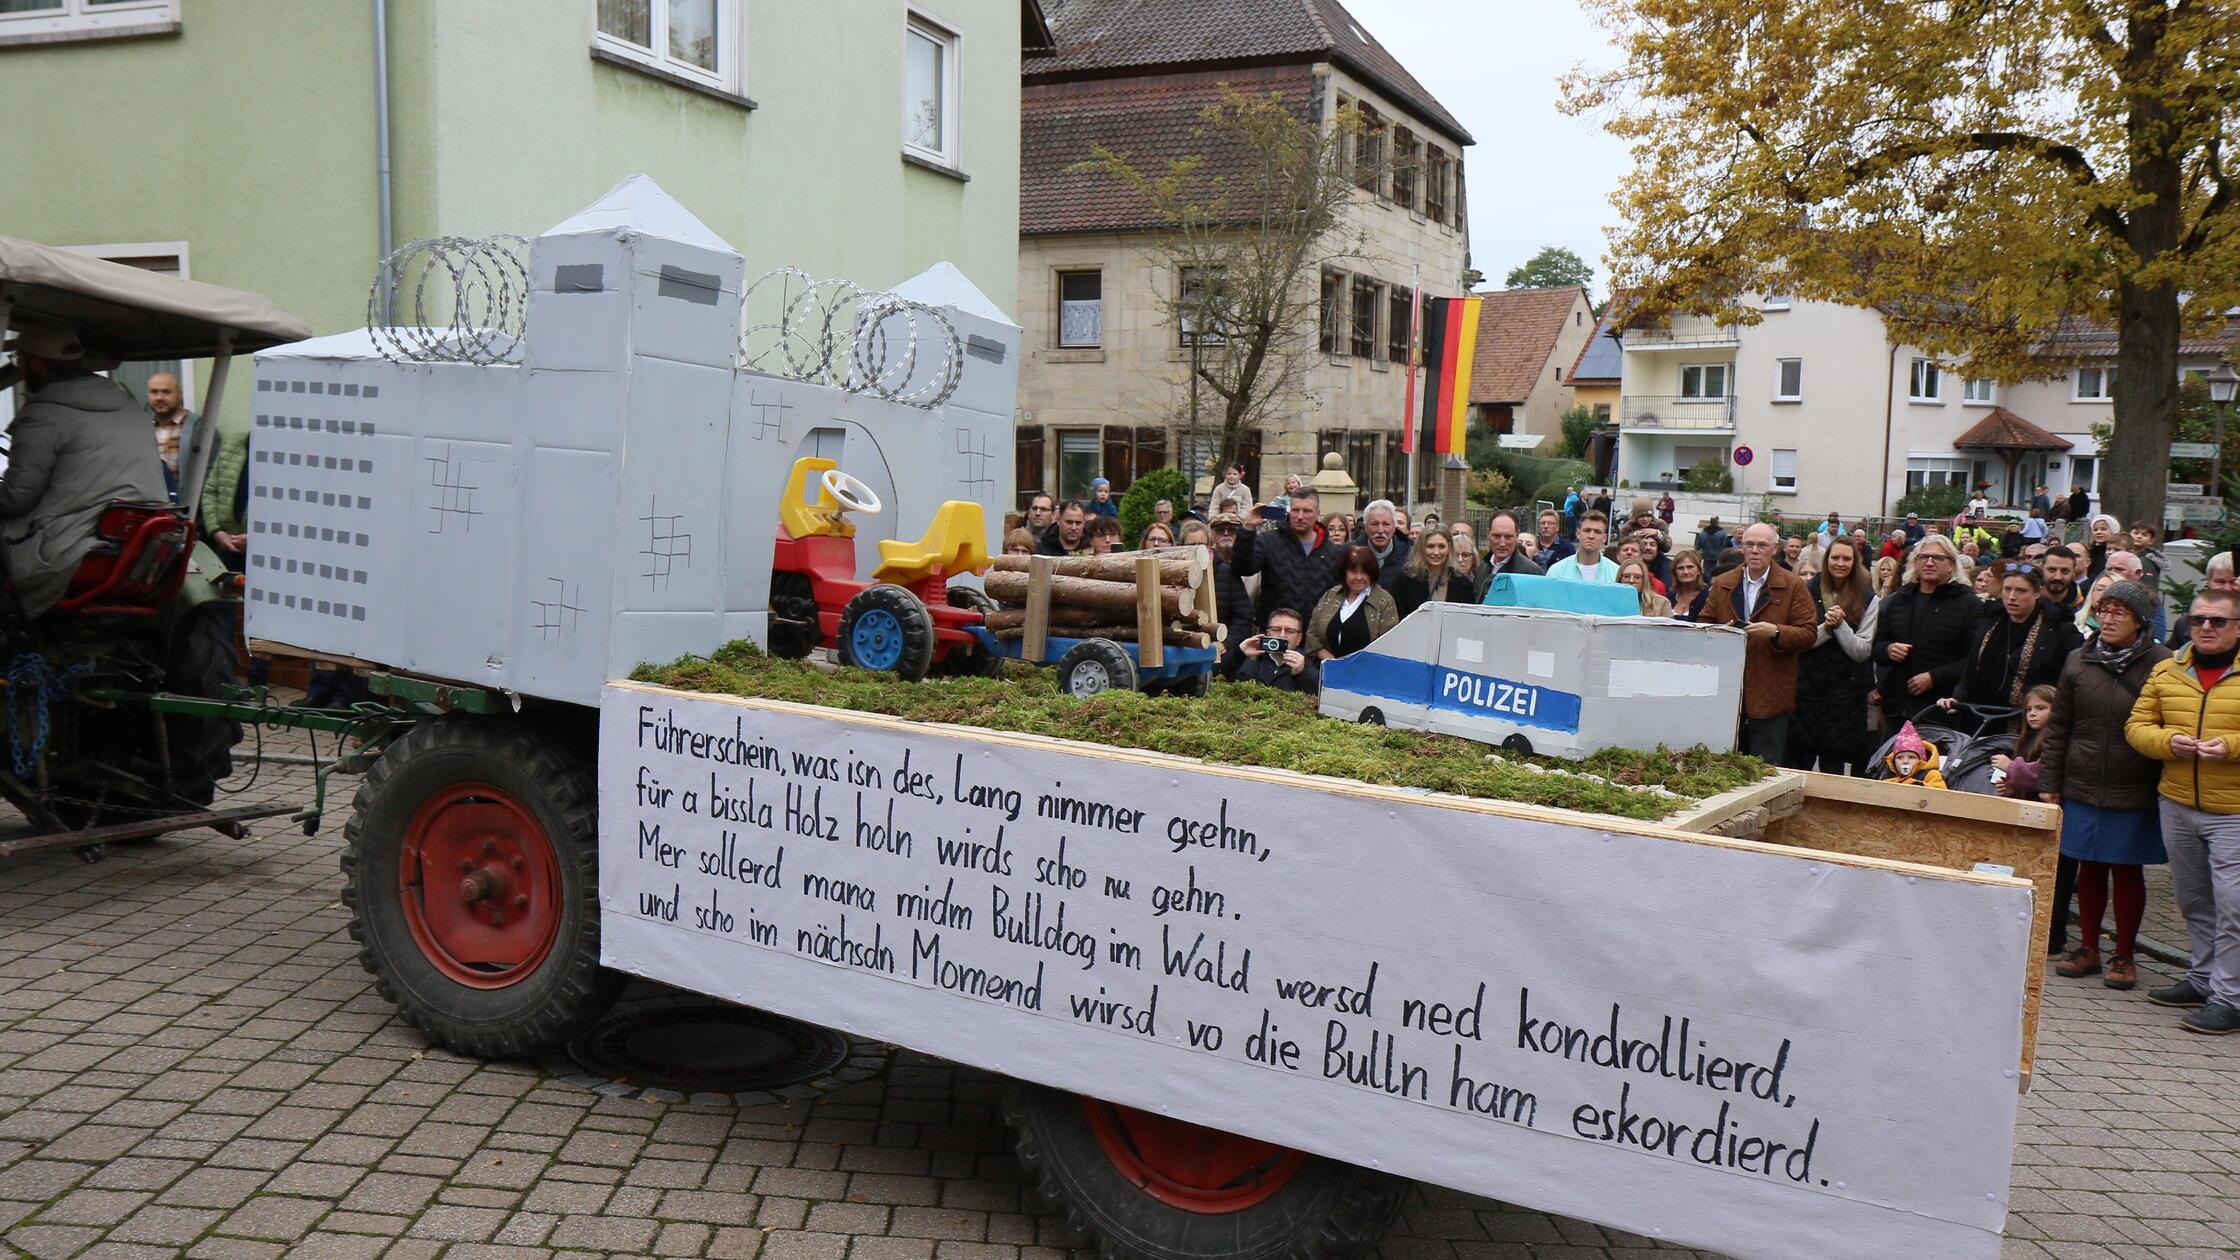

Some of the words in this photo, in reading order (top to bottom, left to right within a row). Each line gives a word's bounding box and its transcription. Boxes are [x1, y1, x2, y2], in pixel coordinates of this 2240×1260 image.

[1443, 672, 1538, 717] POLIZEI
[635, 765, 674, 809] für
[681, 790, 698, 815] a
[710, 771, 773, 830] bissla
[785, 782, 840, 843] Holz
[855, 790, 913, 860] holn
[936, 825, 1014, 878] wirds
[1034, 835, 1087, 891] scho
[1103, 875, 1131, 901] nu
[1151, 865, 1242, 921] gehn.
[638, 705, 787, 777] Führerschein,
[791, 750, 840, 785] was
[847, 748, 882, 791] isn
[892, 747, 945, 807] des,
[1037, 780, 1147, 835] nimmer
[1166, 798, 1271, 863] gsehn,
[638, 820, 687, 870] Mer
[699, 830, 784, 890] sollerd
[803, 873, 876, 912] mana
[896, 877, 973, 933] midm
[992, 884, 1097, 971] Bulldog
[1109, 927, 1141, 973] im
[1162, 923, 1251, 995] Wald
[1275, 960, 1380, 1019] wersd
[1402, 981, 1487, 1042] ned
[1517, 986, 1797, 1109] kondrollierd,
[639, 882, 680, 923] und
[695, 887, 735, 935] scho
[749, 906, 778, 948] im
[797, 914, 895, 975] nächsdn
[911, 927, 1045, 1013] Momend
[1070, 984, 1159, 1038] wirsd
[1186, 1019, 1224, 1053] vo
[1244, 1007, 1302, 1073] die
[1322, 1018, 1429, 1102] Bulln
[1449, 1042, 1539, 1129] ham
[1570, 1081, 1830, 1188] eskordierd.
